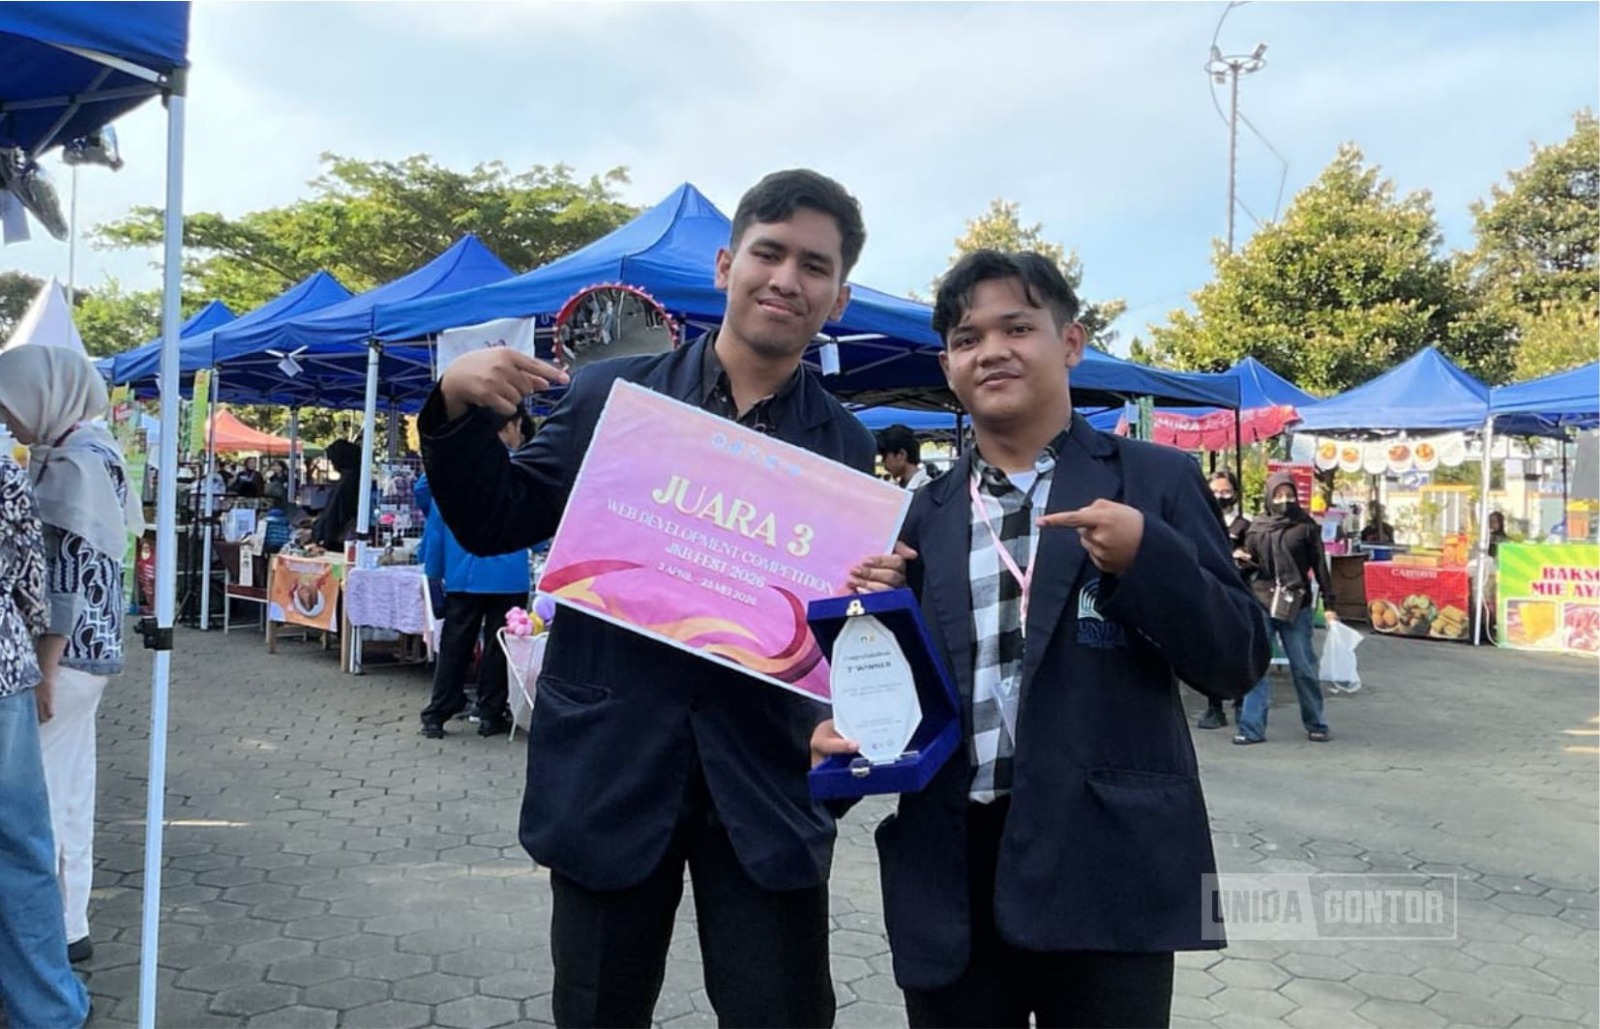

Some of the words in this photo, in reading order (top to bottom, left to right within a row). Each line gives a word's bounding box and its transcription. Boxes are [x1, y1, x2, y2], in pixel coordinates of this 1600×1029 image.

[652, 475, 776, 548] JUARA
[786, 523, 815, 557] 3
[607, 498, 638, 519] WEB
[638, 511, 740, 559] DEVELOPMENT
[741, 550, 834, 597] COMPETITION
[664, 542, 693, 561] JKB
[693, 552, 727, 574] FEST
[729, 565, 765, 589] 2026
[666, 564, 693, 583] APRIL
[714, 582, 732, 597] MEI
[732, 589, 757, 606] 2026
[1531, 583, 1567, 596] MIE
[857, 661, 891, 671] WINNER
